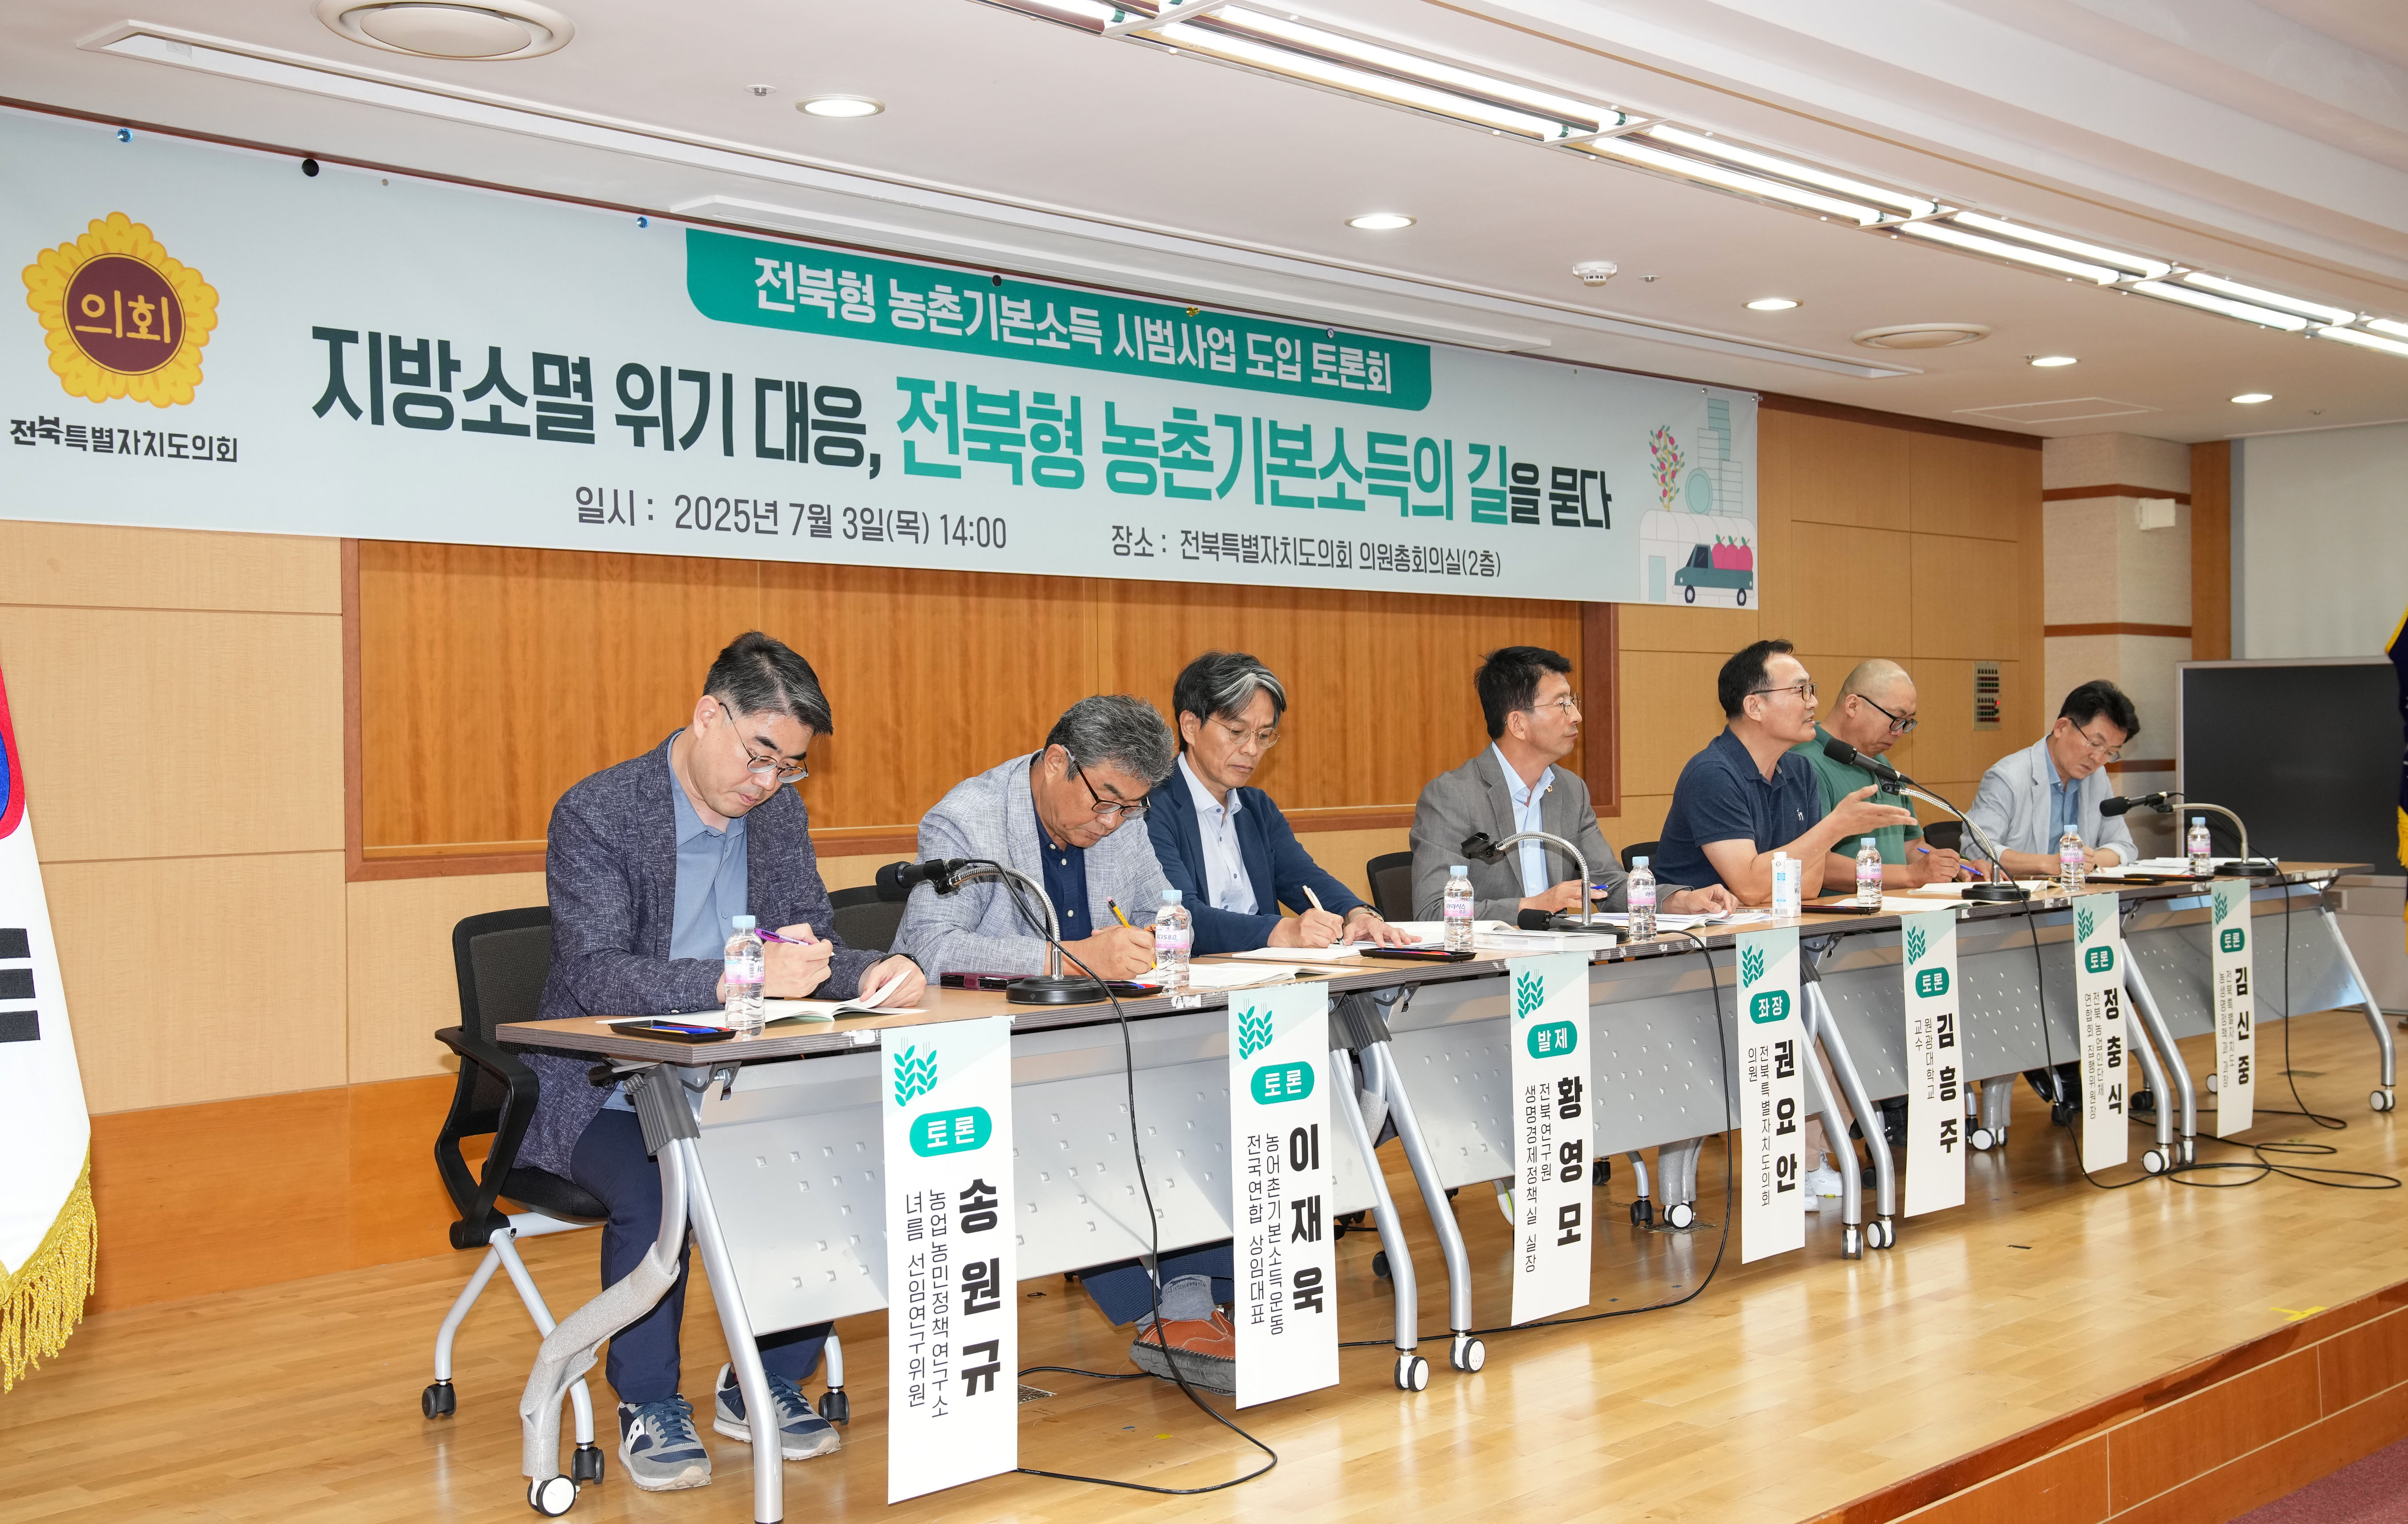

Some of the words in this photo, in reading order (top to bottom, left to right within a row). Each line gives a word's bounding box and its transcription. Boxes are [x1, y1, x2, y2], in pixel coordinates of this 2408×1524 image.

[76, 290, 171, 344] 의회
[755, 257, 875, 323] 전북형
[888, 278, 1102, 354] 농촌기본소득
[1114, 311, 1236, 374] 시범사업
[1246, 334, 1301, 383] 도입
[1311, 345, 1391, 394] 토론회
[10, 415, 237, 462] 전북특별자치도의회
[312, 326, 595, 445] 지방소멸
[615, 362, 734, 457] 위기
[756, 377, 880, 480] 대응,
[896, 375, 1084, 490] 전북형
[1102, 400, 1453, 520] 농촌기본소득의
[1467, 443, 1540, 525] 길을
[1548, 467, 1612, 529] 묻다
[675, 494, 778, 536] 2025년
[789, 502, 832, 539] 7월
[843, 507, 929, 546] 3일(목)
[940, 513, 1006, 548] 14:00
[1180, 530, 1354, 569] 전북특별자치도의회
[1359, 538, 1501, 578] 의원총회의실(2층)
[1923, 973, 1942, 992] 토론
[2090, 951, 2109, 969] 토론
[2224, 932, 2240, 948] 토론
[1538, 1028, 1567, 1052] 발제
[1758, 996, 1782, 1018] 좌장
[1915, 1020, 1923, 1051] 교수
[2235, 967, 2249, 1085] 김신중
[1265, 1069, 1302, 1097] 토론
[1749, 1048, 1757, 1082] 의원
[1925, 1018, 1934, 1099] 원광대학교
[1937, 1013, 1957, 1153] 김흥주
[2088, 1045, 2096, 1119] 집행위원장
[2104, 988, 2121, 1114] 정충식
[927, 1116, 975, 1148] 토론
[1525, 1085, 1537, 1225] 생명경제정책실
[1540, 1083, 1551, 1181] 전북연구원
[1760, 1045, 1770, 1206] 전북특별자치도의회
[1775, 1040, 1797, 1193] 권요안
[1247, 1134, 1263, 1224] 전국연합
[1558, 1076, 1582, 1246] 황영모
[906, 1191, 922, 1241] 너름
[1266, 1133, 1283, 1335] 농어촌기본소득운동
[1290, 1124, 1323, 1314] 이재욱
[1526, 1234, 1536, 1272] 실장
[929, 1189, 948, 1418] 농업농민정책연구소
[960, 1178, 1001, 1397] 송원규
[1250, 1234, 1264, 1324] 상임대표
[908, 1253, 925, 1407] 선임연구위원
